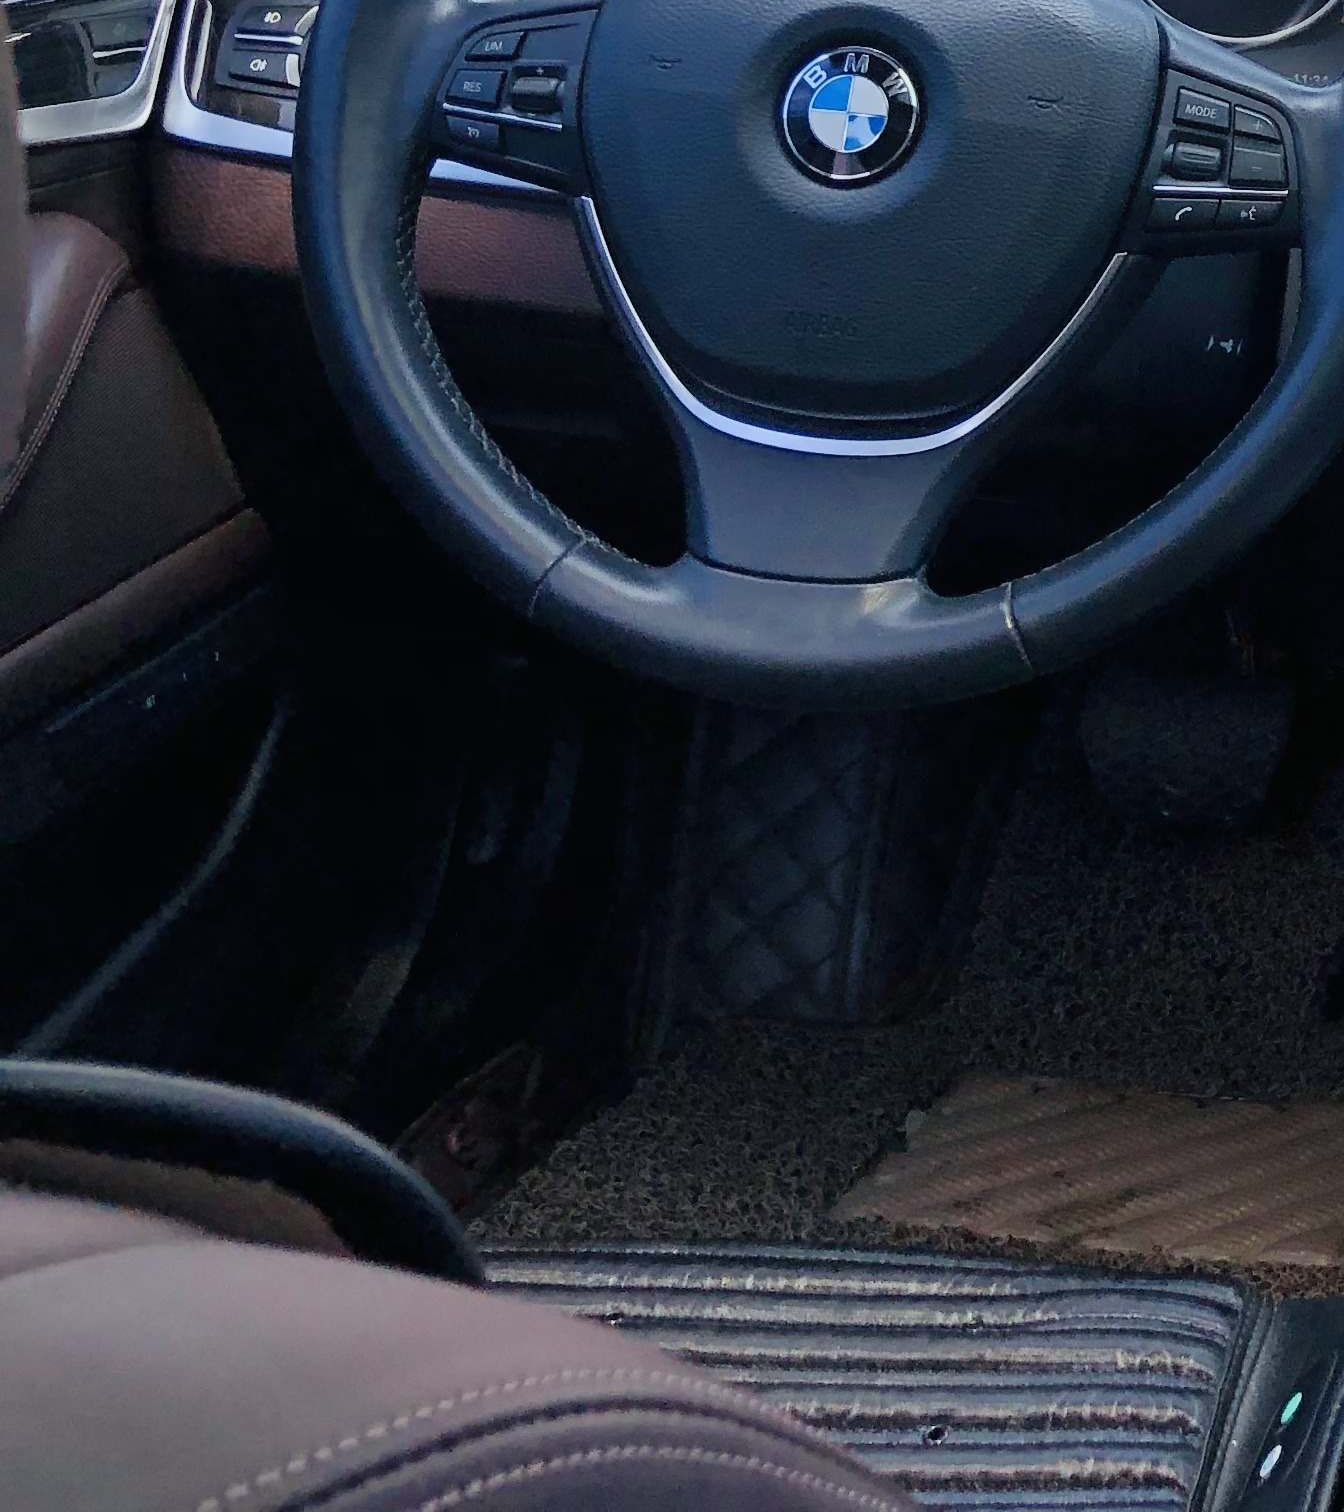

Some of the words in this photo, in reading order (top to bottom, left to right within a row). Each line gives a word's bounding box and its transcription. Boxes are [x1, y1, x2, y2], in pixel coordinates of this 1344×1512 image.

[803, 53, 909, 97] BMW
[463, 80, 482, 93] RES
[1184, 103, 1218, 119] MODE
